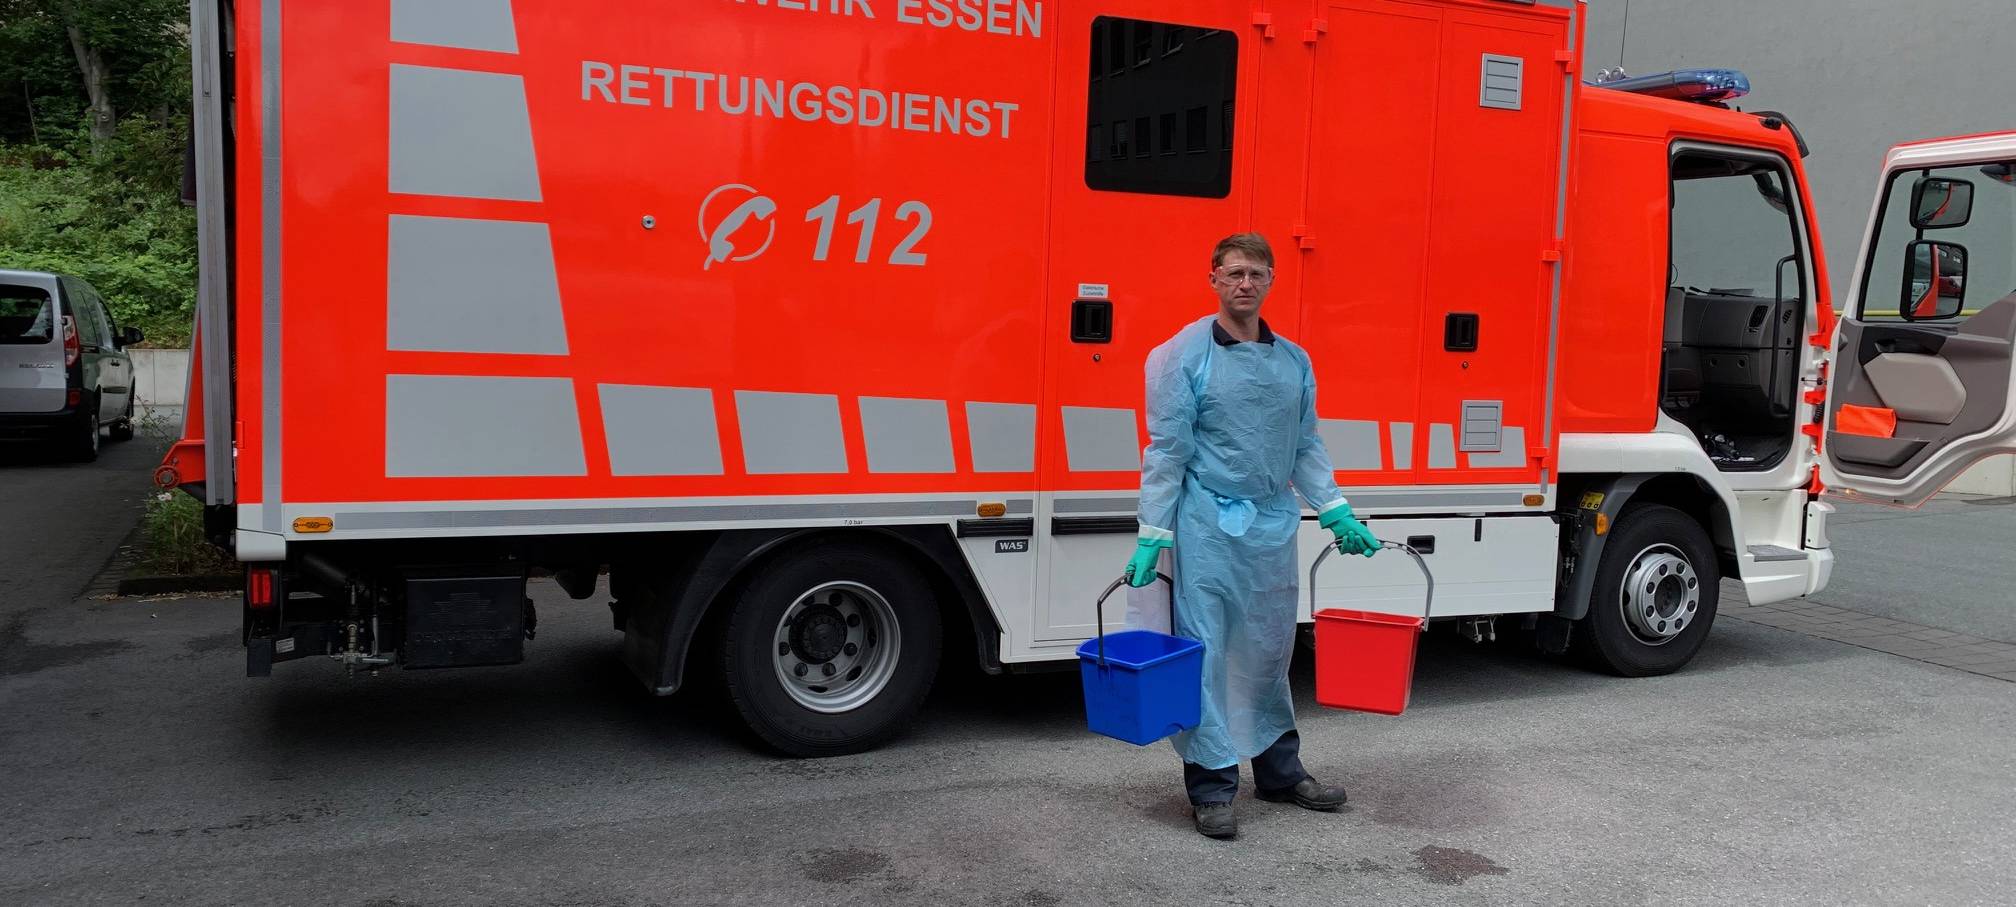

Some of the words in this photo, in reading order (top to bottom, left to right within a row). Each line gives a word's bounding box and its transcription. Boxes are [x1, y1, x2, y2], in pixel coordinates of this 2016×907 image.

[896, 0, 1042, 38] ESSEN
[581, 60, 1019, 139] RETTUNGSDIENST
[805, 194, 933, 266] 112
[1000, 541, 1023, 550] WAS
